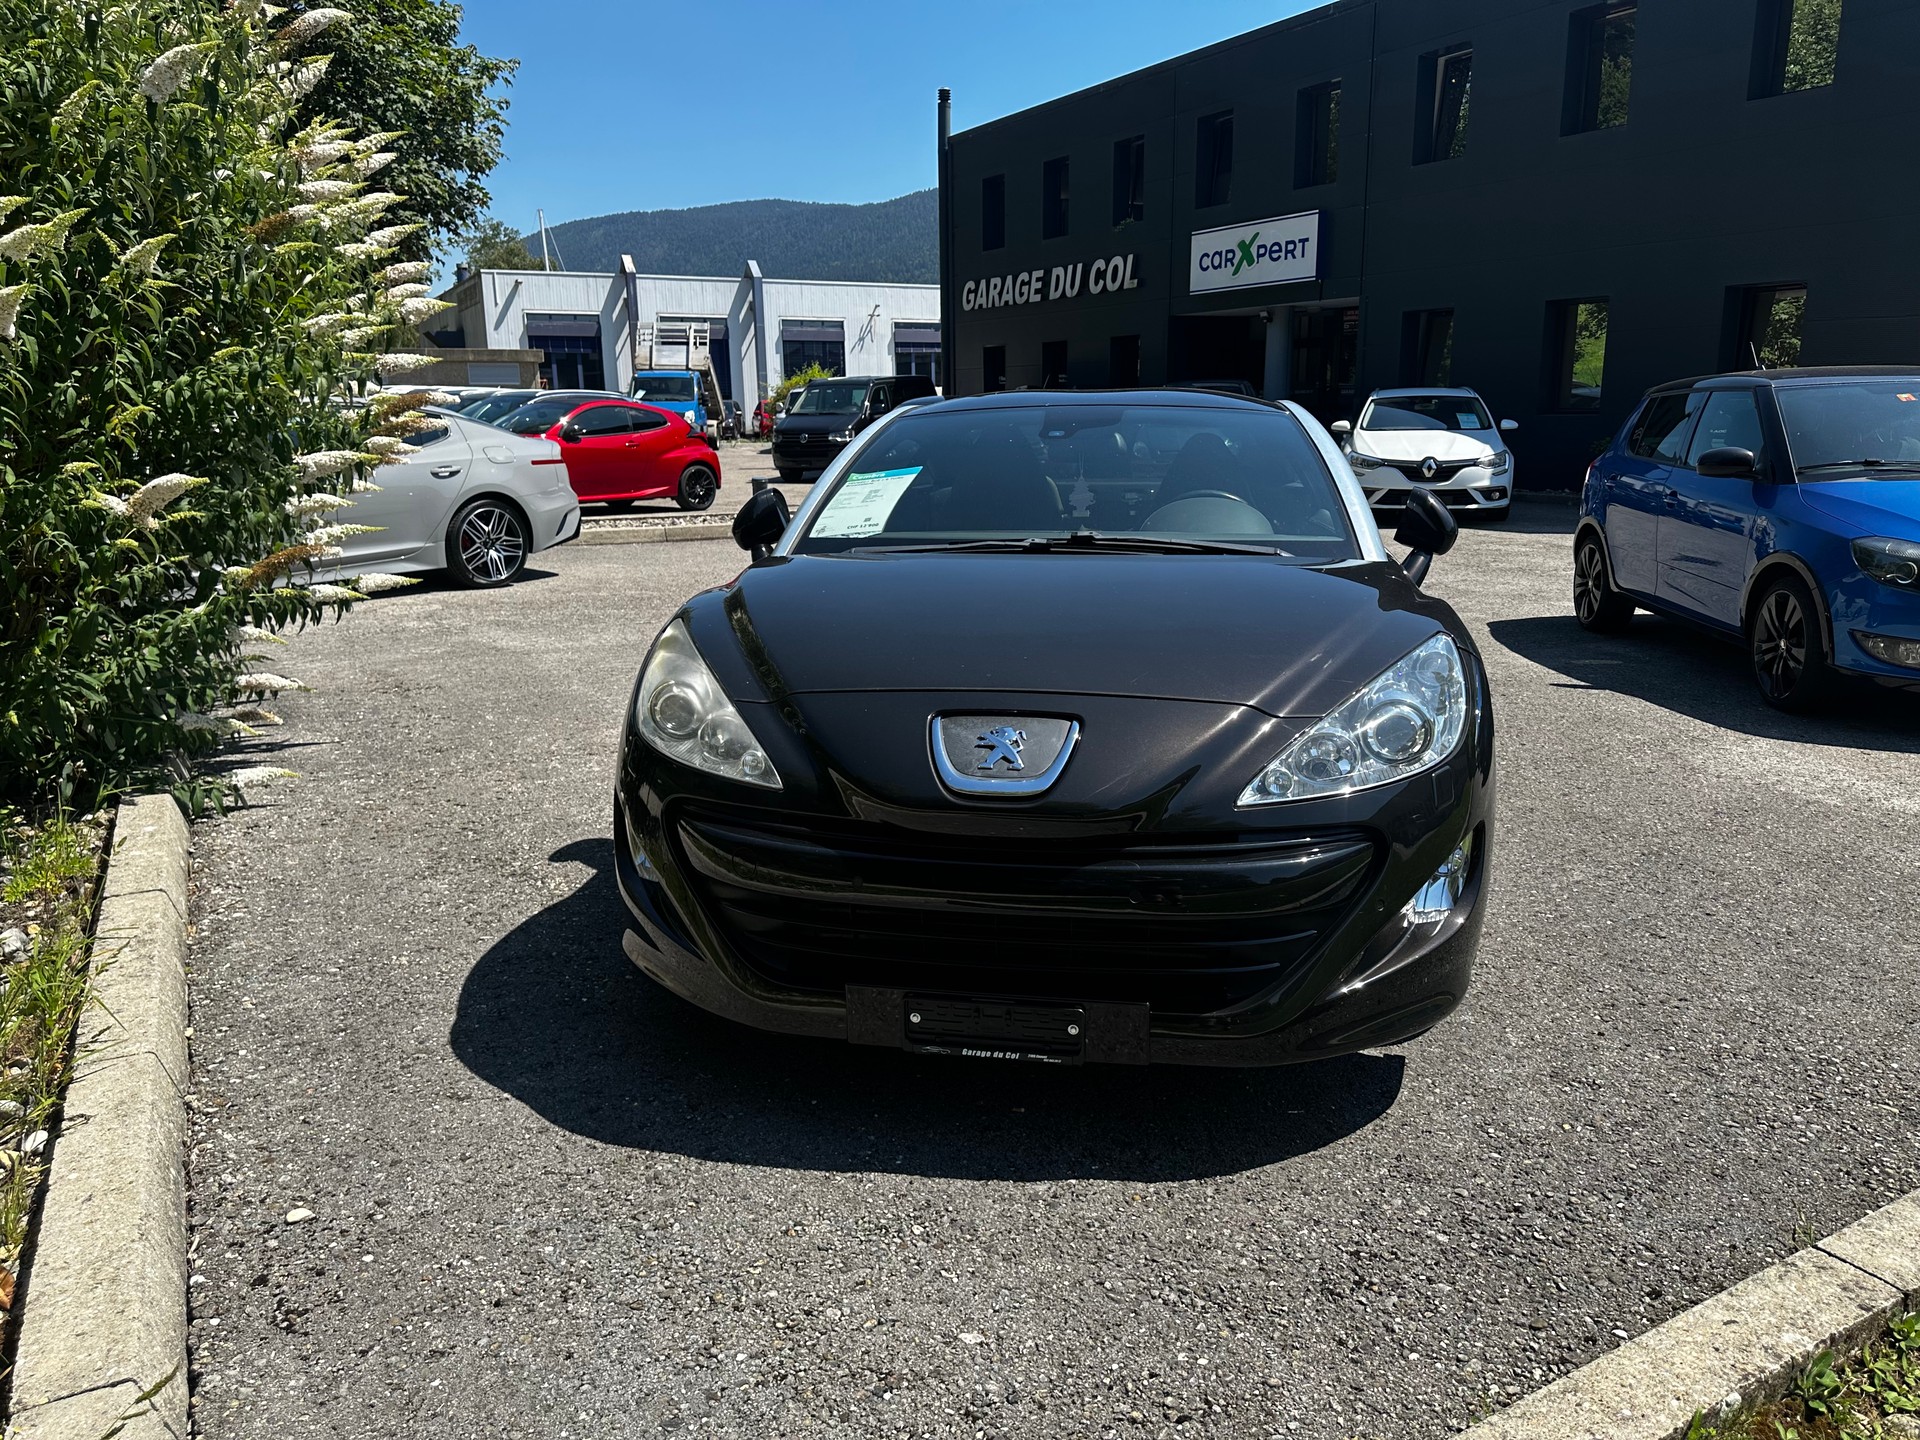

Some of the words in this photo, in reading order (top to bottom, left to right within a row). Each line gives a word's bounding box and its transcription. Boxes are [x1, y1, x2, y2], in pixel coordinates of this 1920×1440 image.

[962, 269, 1045, 312] GARAGE
[1049, 262, 1084, 301] DU
[1089, 253, 1139, 295] COL
[962, 1048, 992, 1058] Garage
[993, 1051, 1004, 1059] du
[1005, 1051, 1020, 1060] Col
